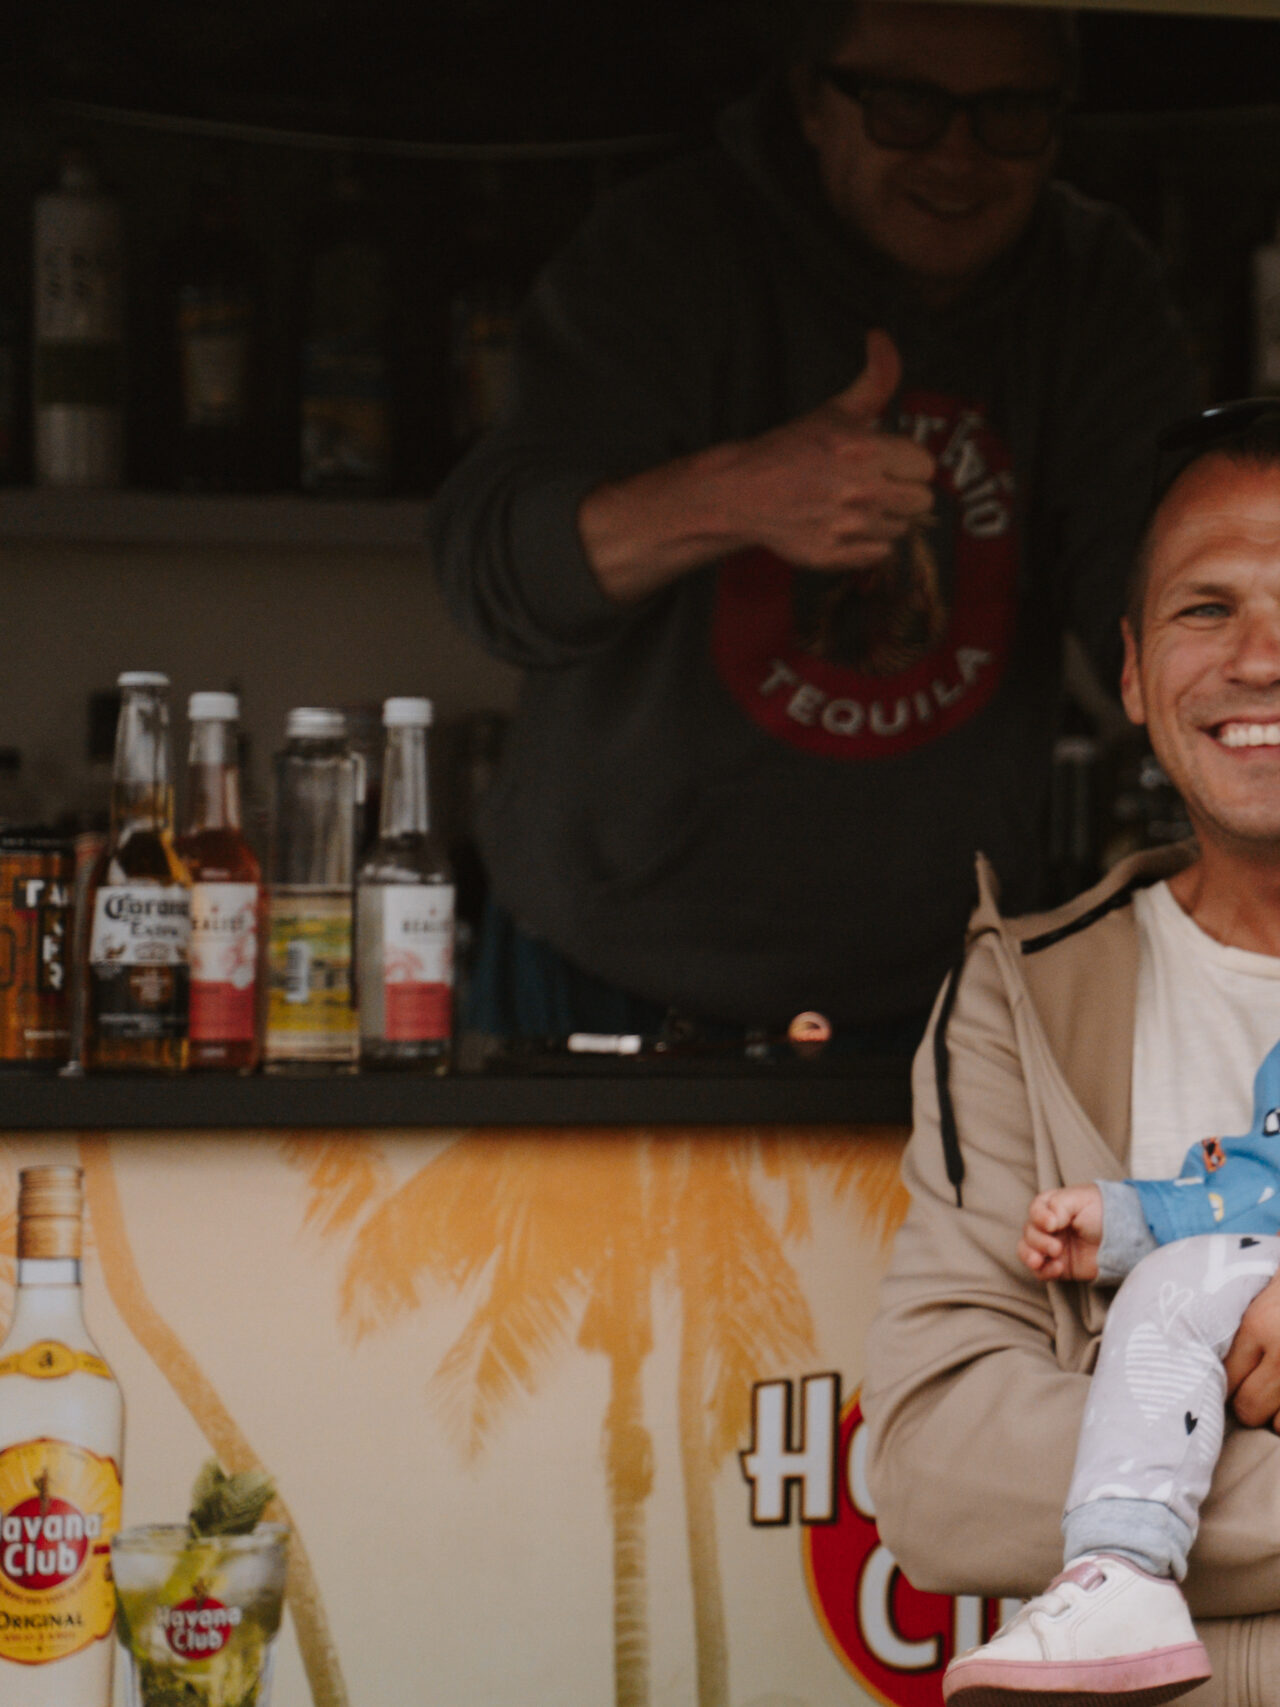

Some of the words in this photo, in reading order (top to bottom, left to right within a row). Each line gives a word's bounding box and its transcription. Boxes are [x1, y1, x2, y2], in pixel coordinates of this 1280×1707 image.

[758, 645, 992, 738] TEQUILA
[0, 1512, 101, 1543] avana
[3, 1540, 79, 1578] Club
[171, 1627, 224, 1651] Club
